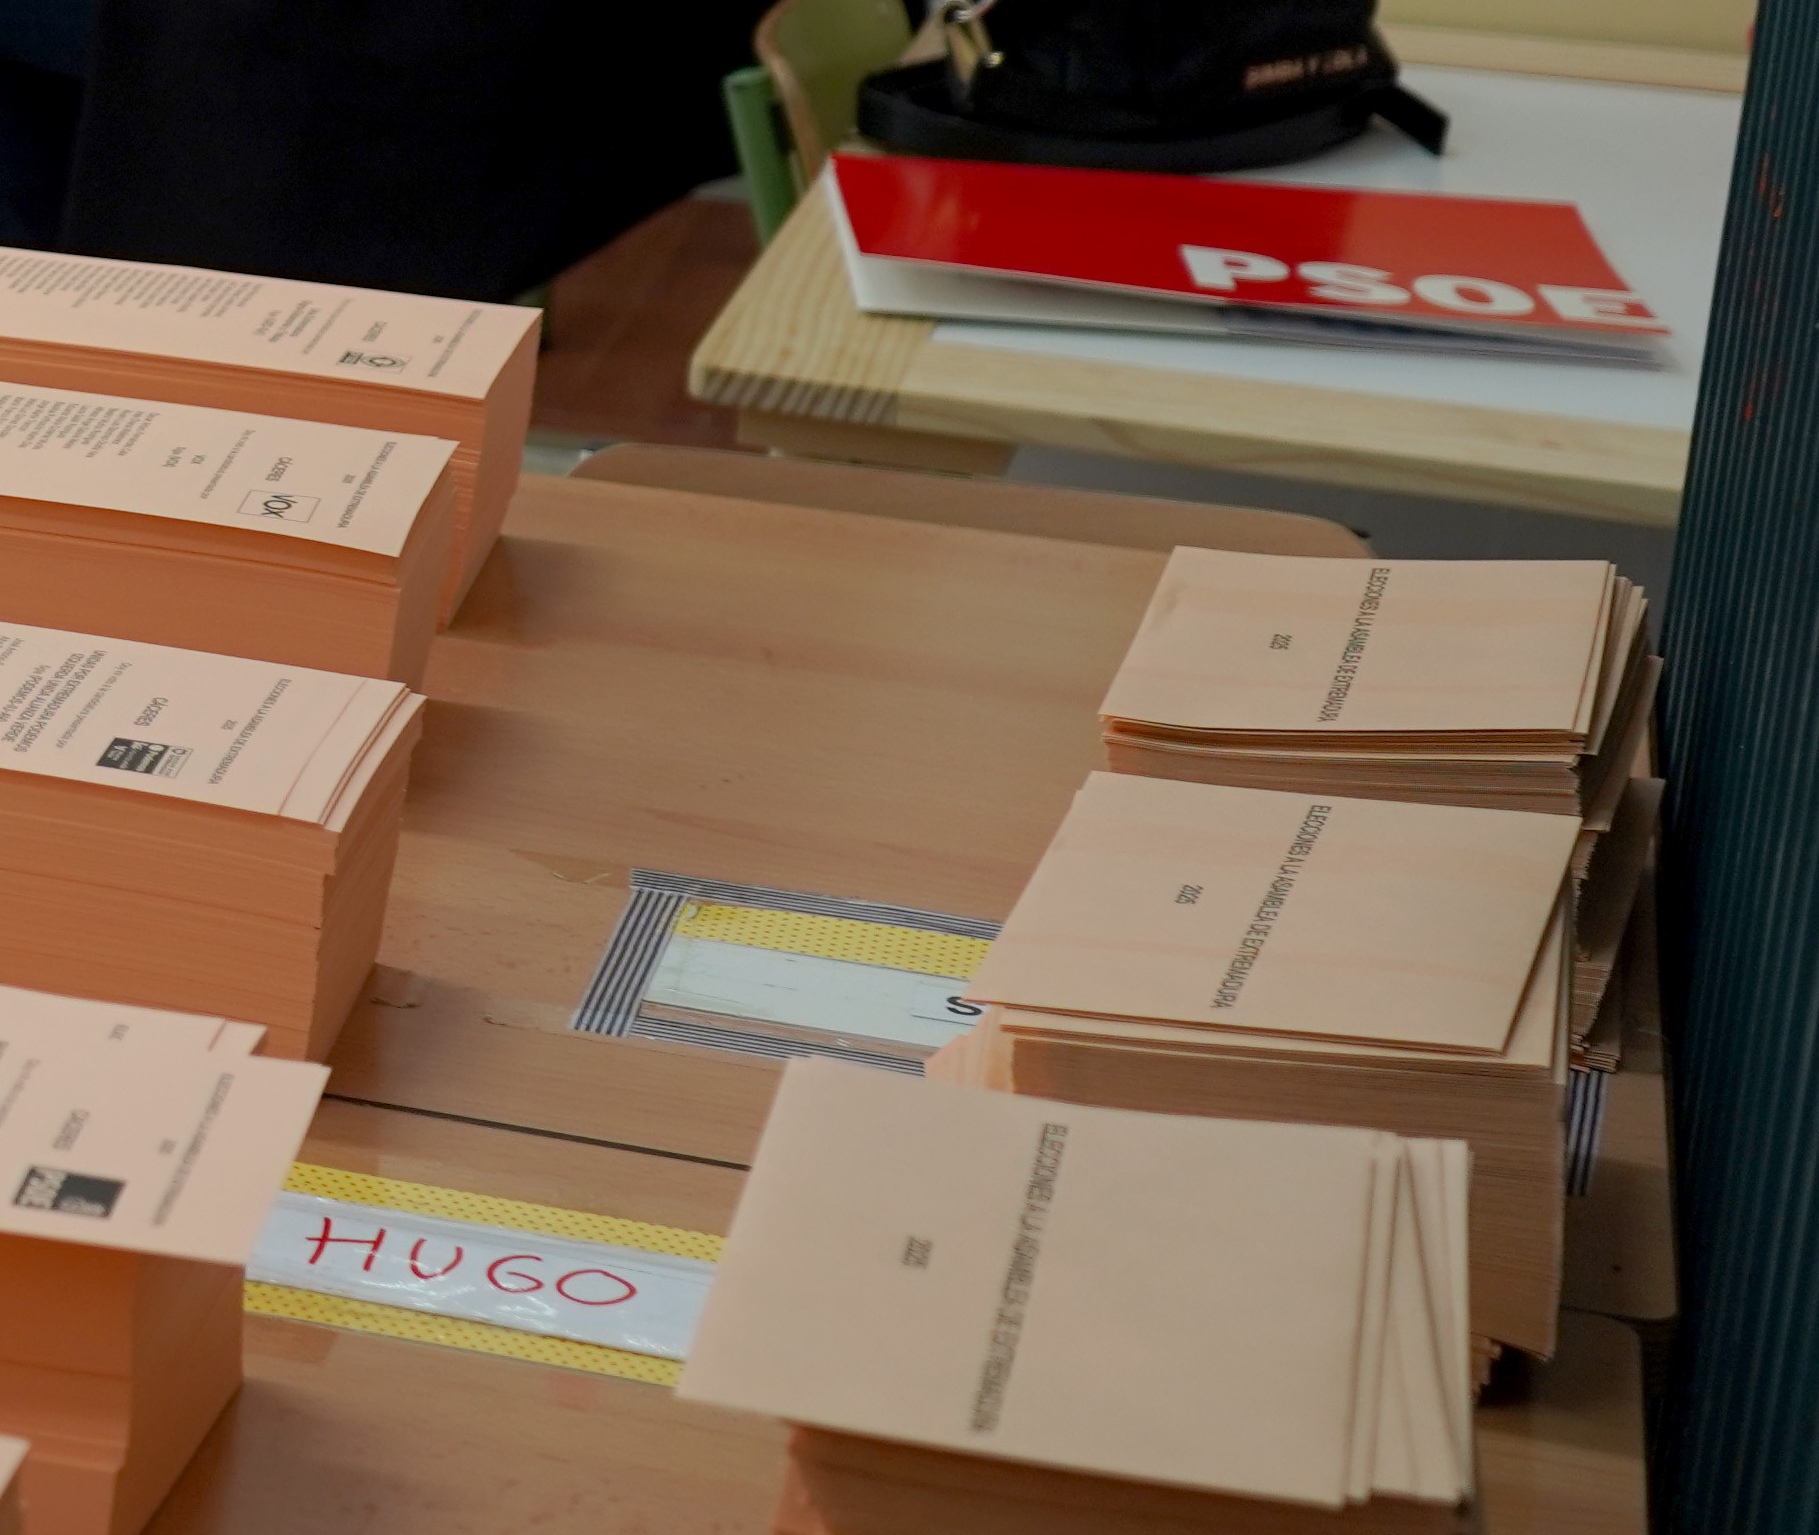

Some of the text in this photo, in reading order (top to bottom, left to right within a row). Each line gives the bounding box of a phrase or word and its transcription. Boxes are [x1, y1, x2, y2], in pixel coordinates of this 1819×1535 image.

[1178, 243, 1665, 330] PSOE
[255, 492, 301, 518] VOX
[1358, 567, 1391, 610] ELECCIONES
[1352, 617, 1374, 627] LA
[1267, 633, 1293, 650] 2025
[1338, 627, 1370, 664] ASAMBLEA
[1334, 664, 1357, 674] DE
[129, 696, 174, 727] CÁCERES
[1316, 674, 1353, 723] EXTREMADURA
[1286, 804, 1332, 856] ELECCIONES
[1276, 864, 1303, 876] LA
[1173, 884, 1204, 904] 2025
[1253, 875, 1297, 922] ASAMBLEA
[1246, 923, 1274, 937] DE
[1210, 937, 1267, 1009] EXTREMADURA
[306, 1217, 637, 1305] HUGO
